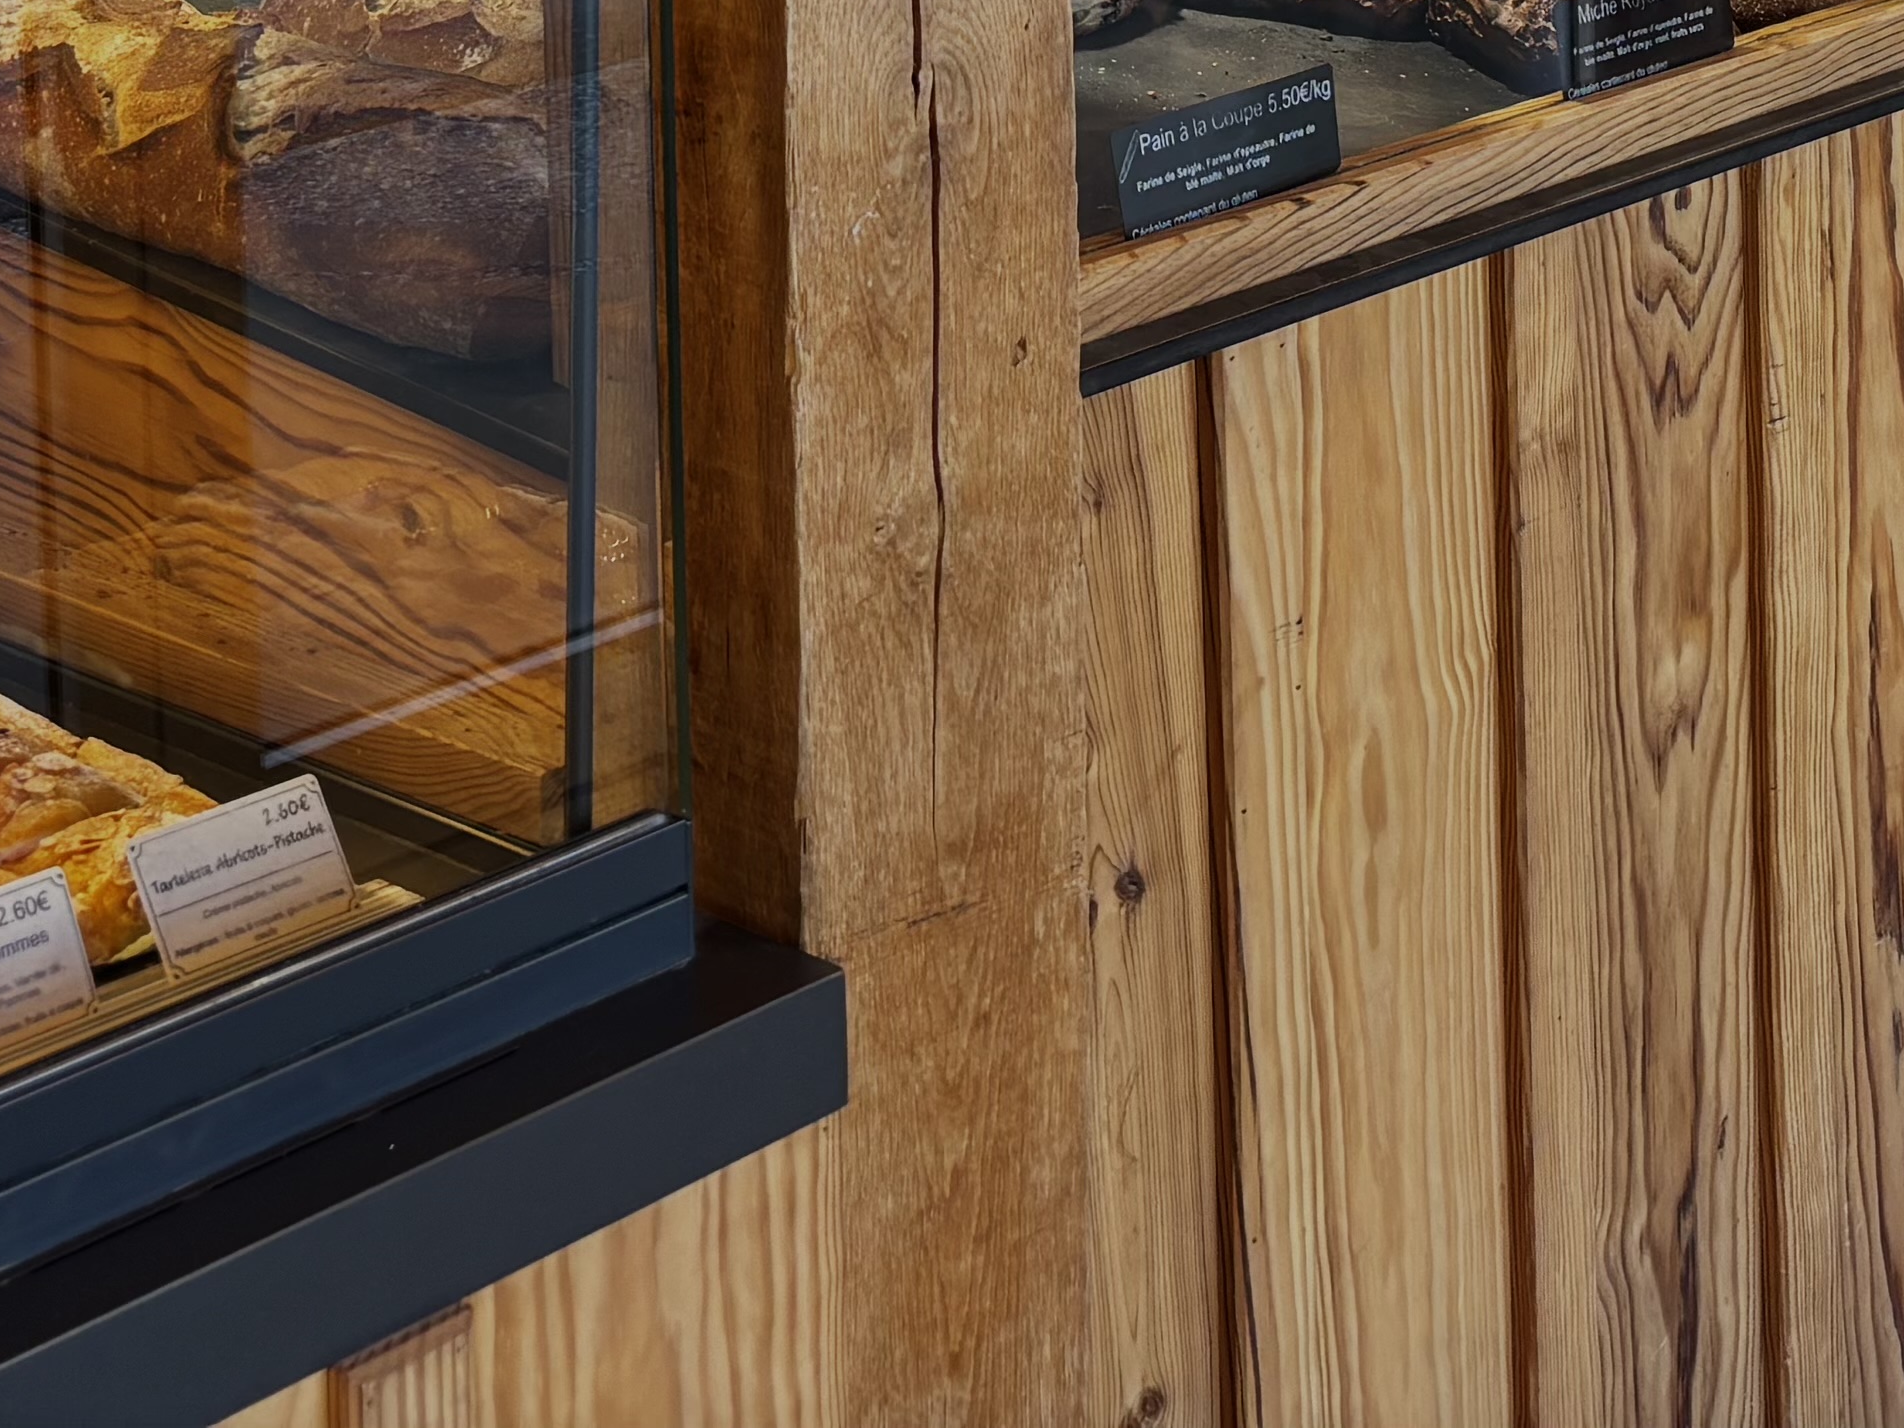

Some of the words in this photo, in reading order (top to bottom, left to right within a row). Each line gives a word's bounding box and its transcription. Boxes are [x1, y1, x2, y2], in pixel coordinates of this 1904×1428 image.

[1577, 0, 1617, 25] Miche
[1138, 128, 1176, 156] Pain
[1179, 121, 1189, 142] à
[1192, 117, 1207, 138] la
[1211, 101, 1263, 130] Coupe
[1267, 78, 1332, 116] 5.50€/kg
[1164, 172, 1176, 184] de
[1305, 123, 1316, 135] de
[262, 793, 311, 826] 2.60€
